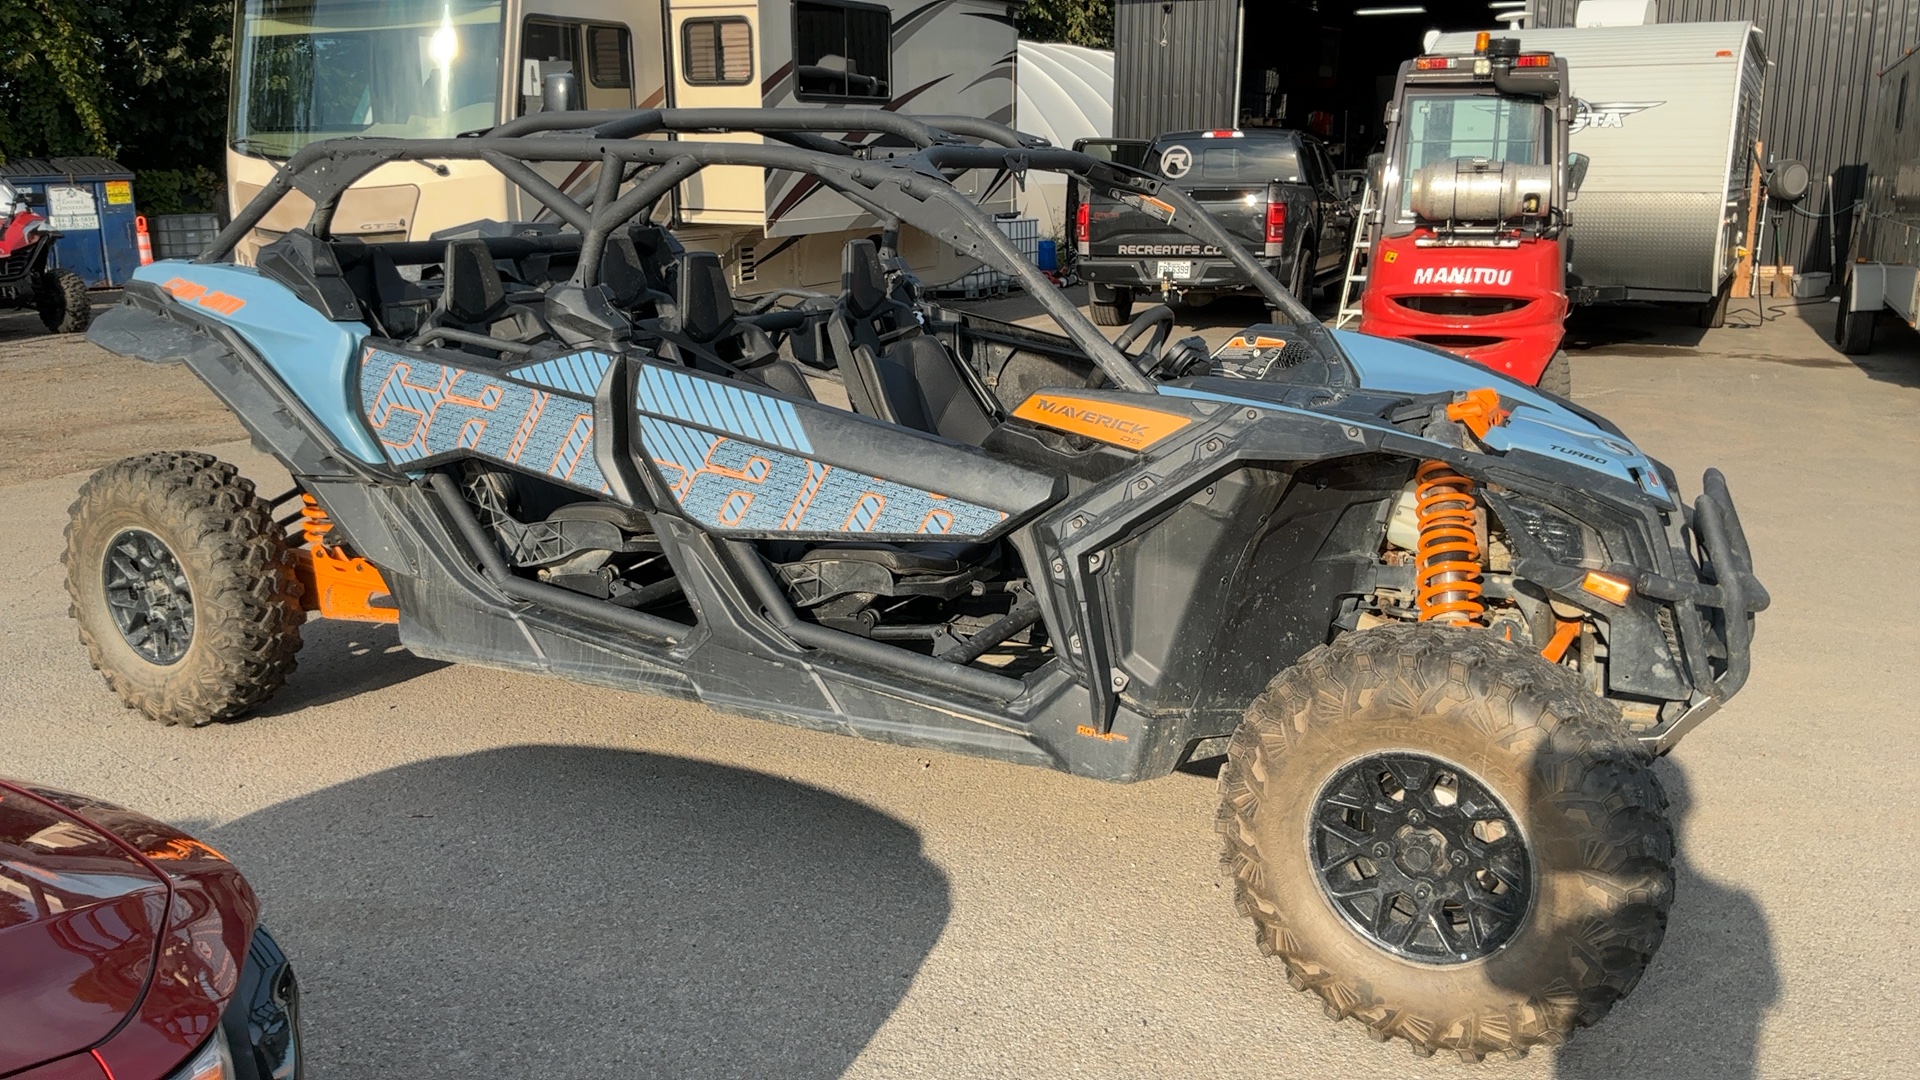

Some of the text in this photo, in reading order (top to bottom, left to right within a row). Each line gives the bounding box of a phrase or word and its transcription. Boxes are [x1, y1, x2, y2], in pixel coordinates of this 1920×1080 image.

[1413, 267, 1512, 286] MANITOU
[1036, 399, 1150, 438] MAVERICK
[1549, 443, 1608, 465] TURBO
